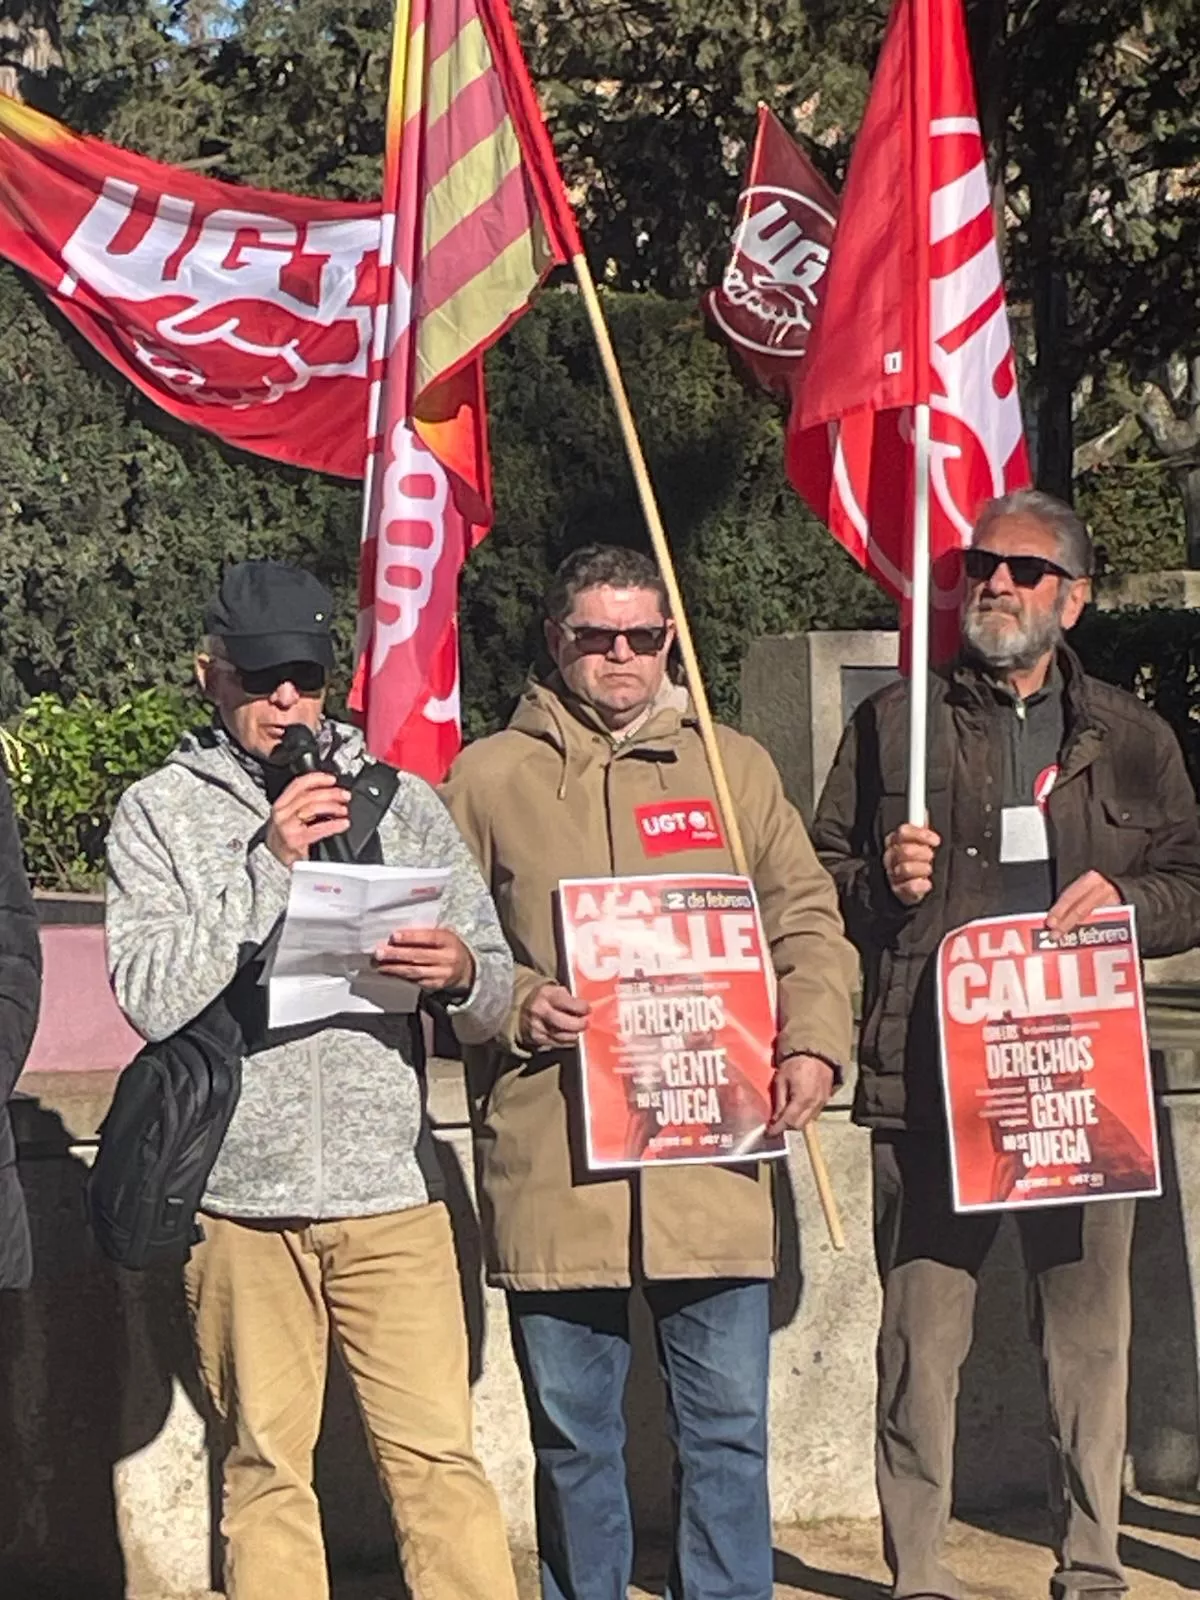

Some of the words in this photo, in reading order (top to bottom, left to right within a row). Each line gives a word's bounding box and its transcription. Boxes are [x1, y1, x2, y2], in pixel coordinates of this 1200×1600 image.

[61, 176, 384, 326] UGT
[641, 811, 687, 836] UGT
[575, 893, 597, 919] A
[667, 892, 686, 909] 2
[687, 891, 706, 908] de
[706, 890, 751, 908] febrero
[574, 914, 760, 981] CALLE
[949, 935, 974, 963] A
[978, 929, 1026, 959] LA
[1079, 926, 1129, 945] febrero
[947, 949, 1135, 1025] CALLE
[619, 995, 725, 1036] DERECHOS
[664, 1048, 729, 1088] GENTE
[985, 1036, 1095, 1080] DERECHOS
[656, 1088, 722, 1127] JUEGA
[1030, 1088, 1099, 1129] GENTE
[1022, 1128, 1092, 1168] JUEGA
